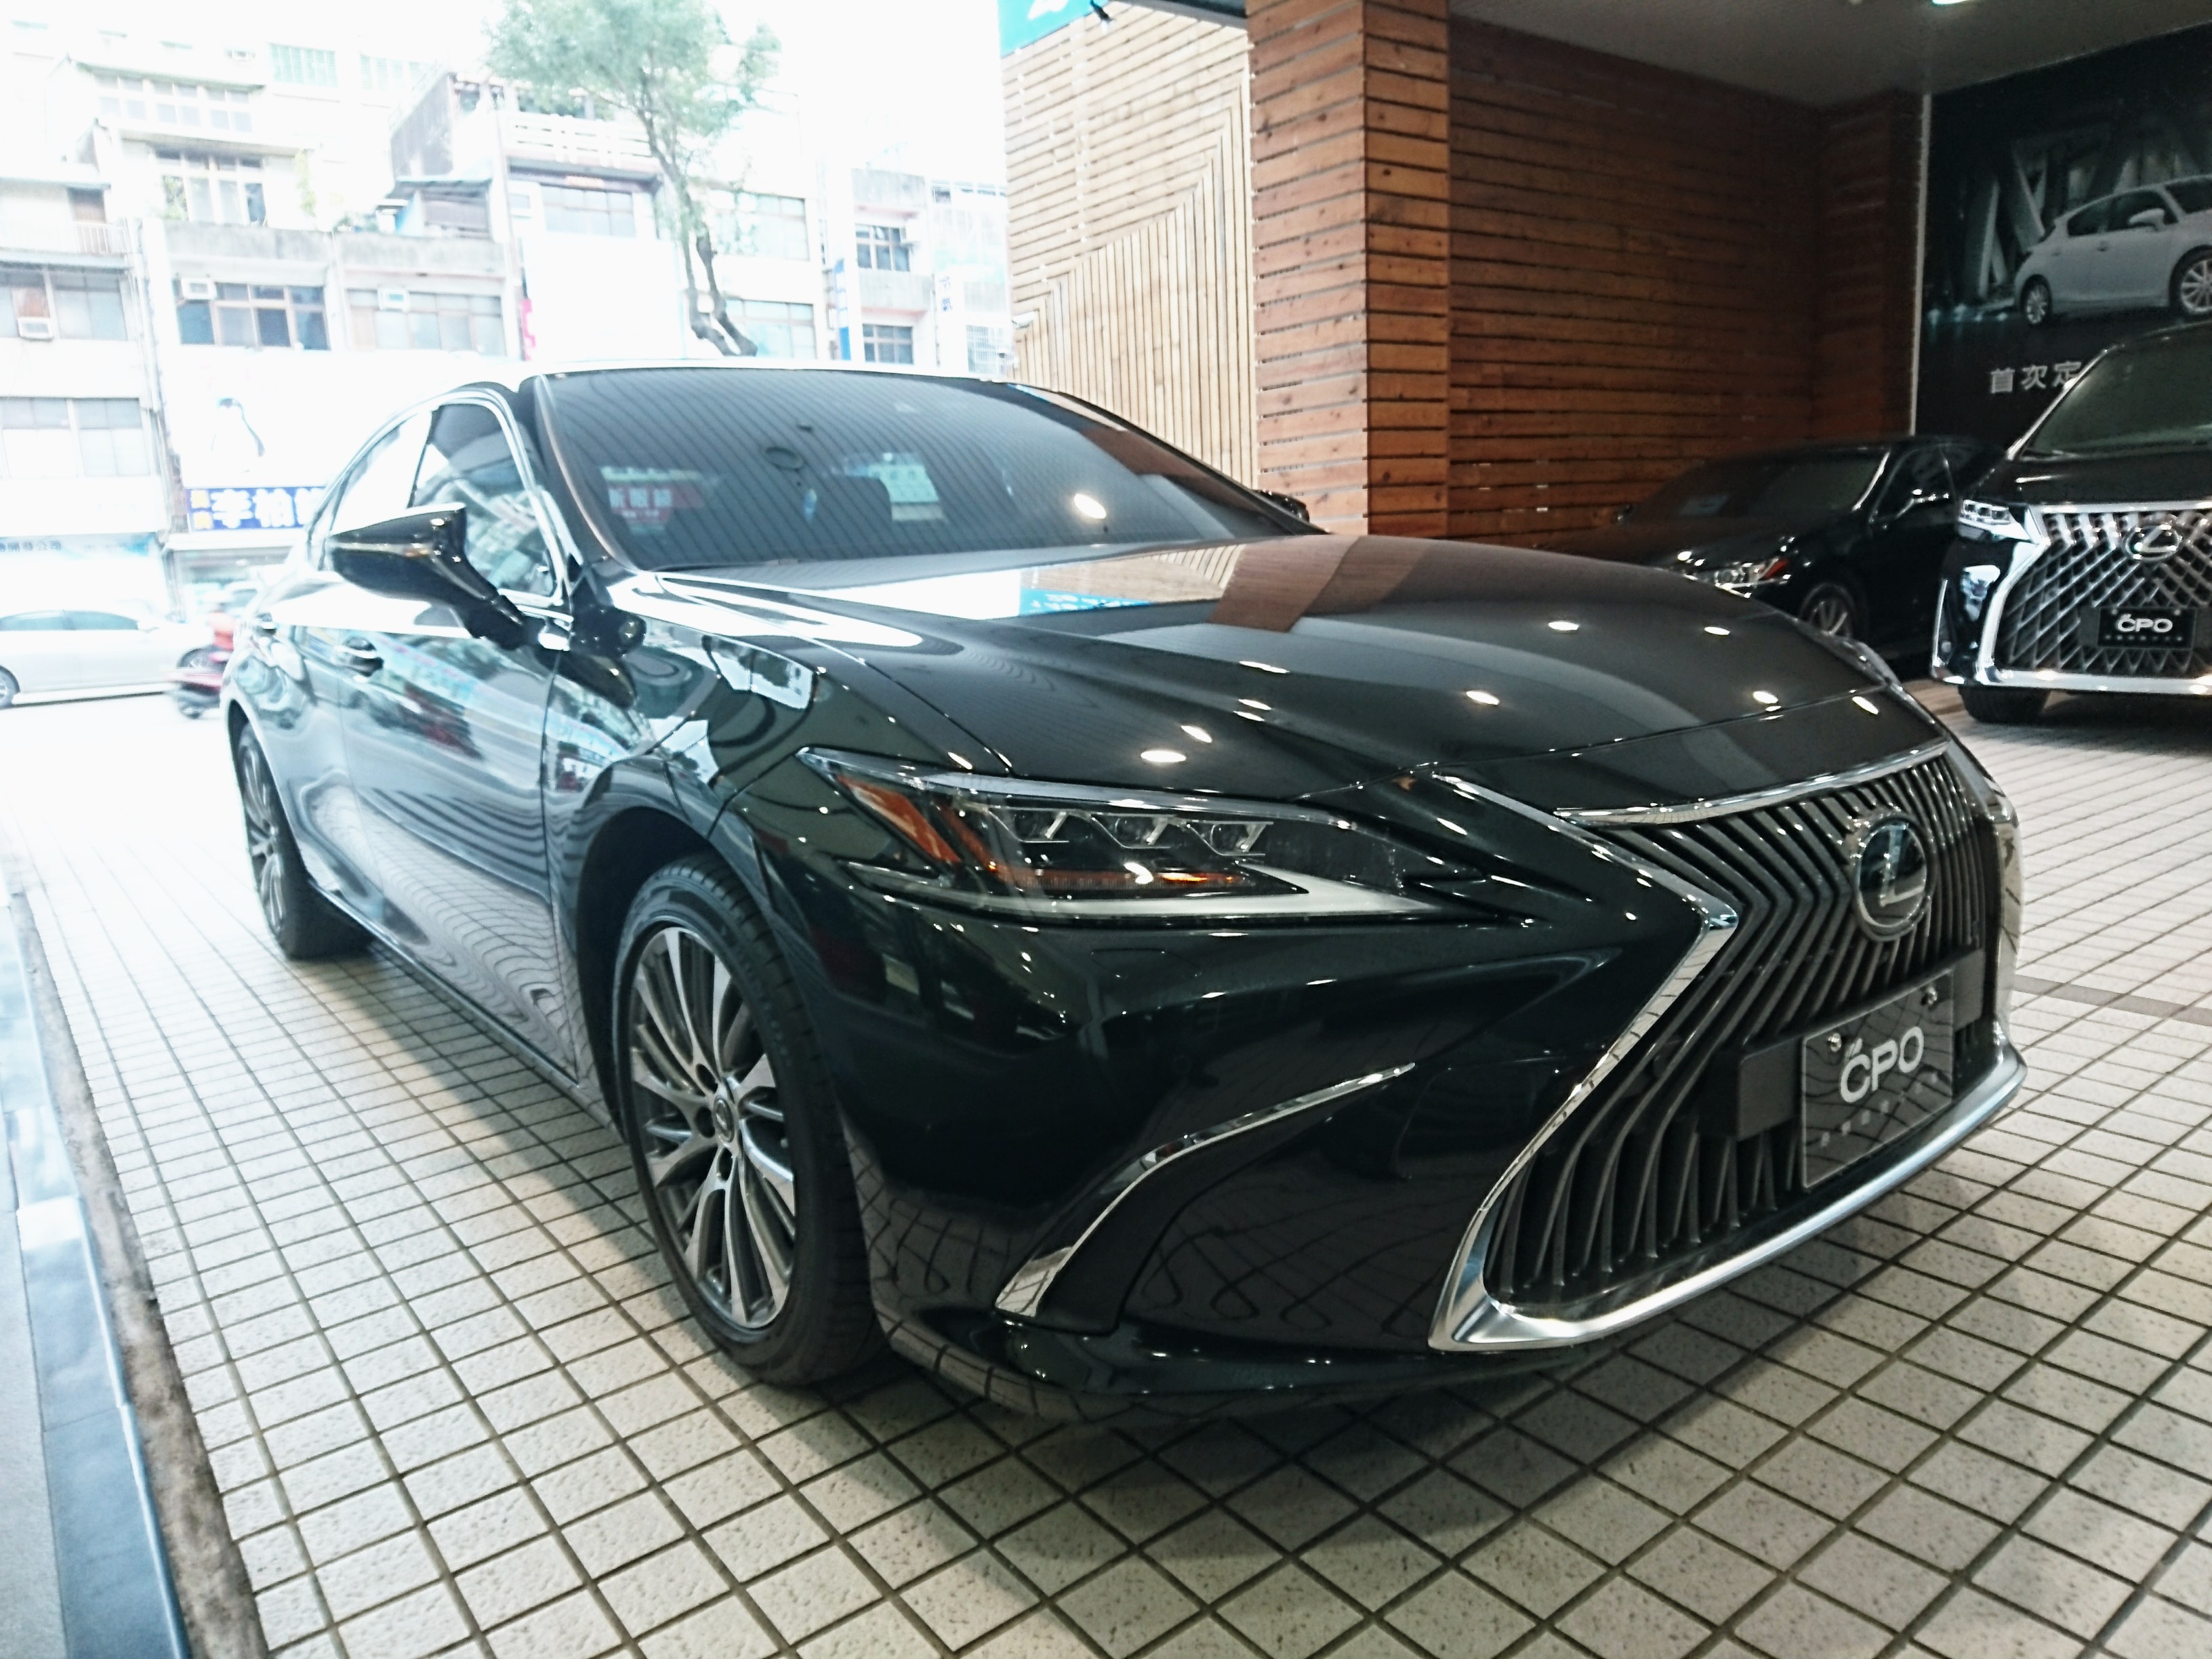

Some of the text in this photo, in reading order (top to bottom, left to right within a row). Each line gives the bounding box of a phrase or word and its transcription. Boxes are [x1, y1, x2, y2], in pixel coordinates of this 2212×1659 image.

[1990, 361, 2082, 394] 首次定
[2117, 614, 2173, 633] CPO
[1841, 1026, 1924, 1103] CPO
